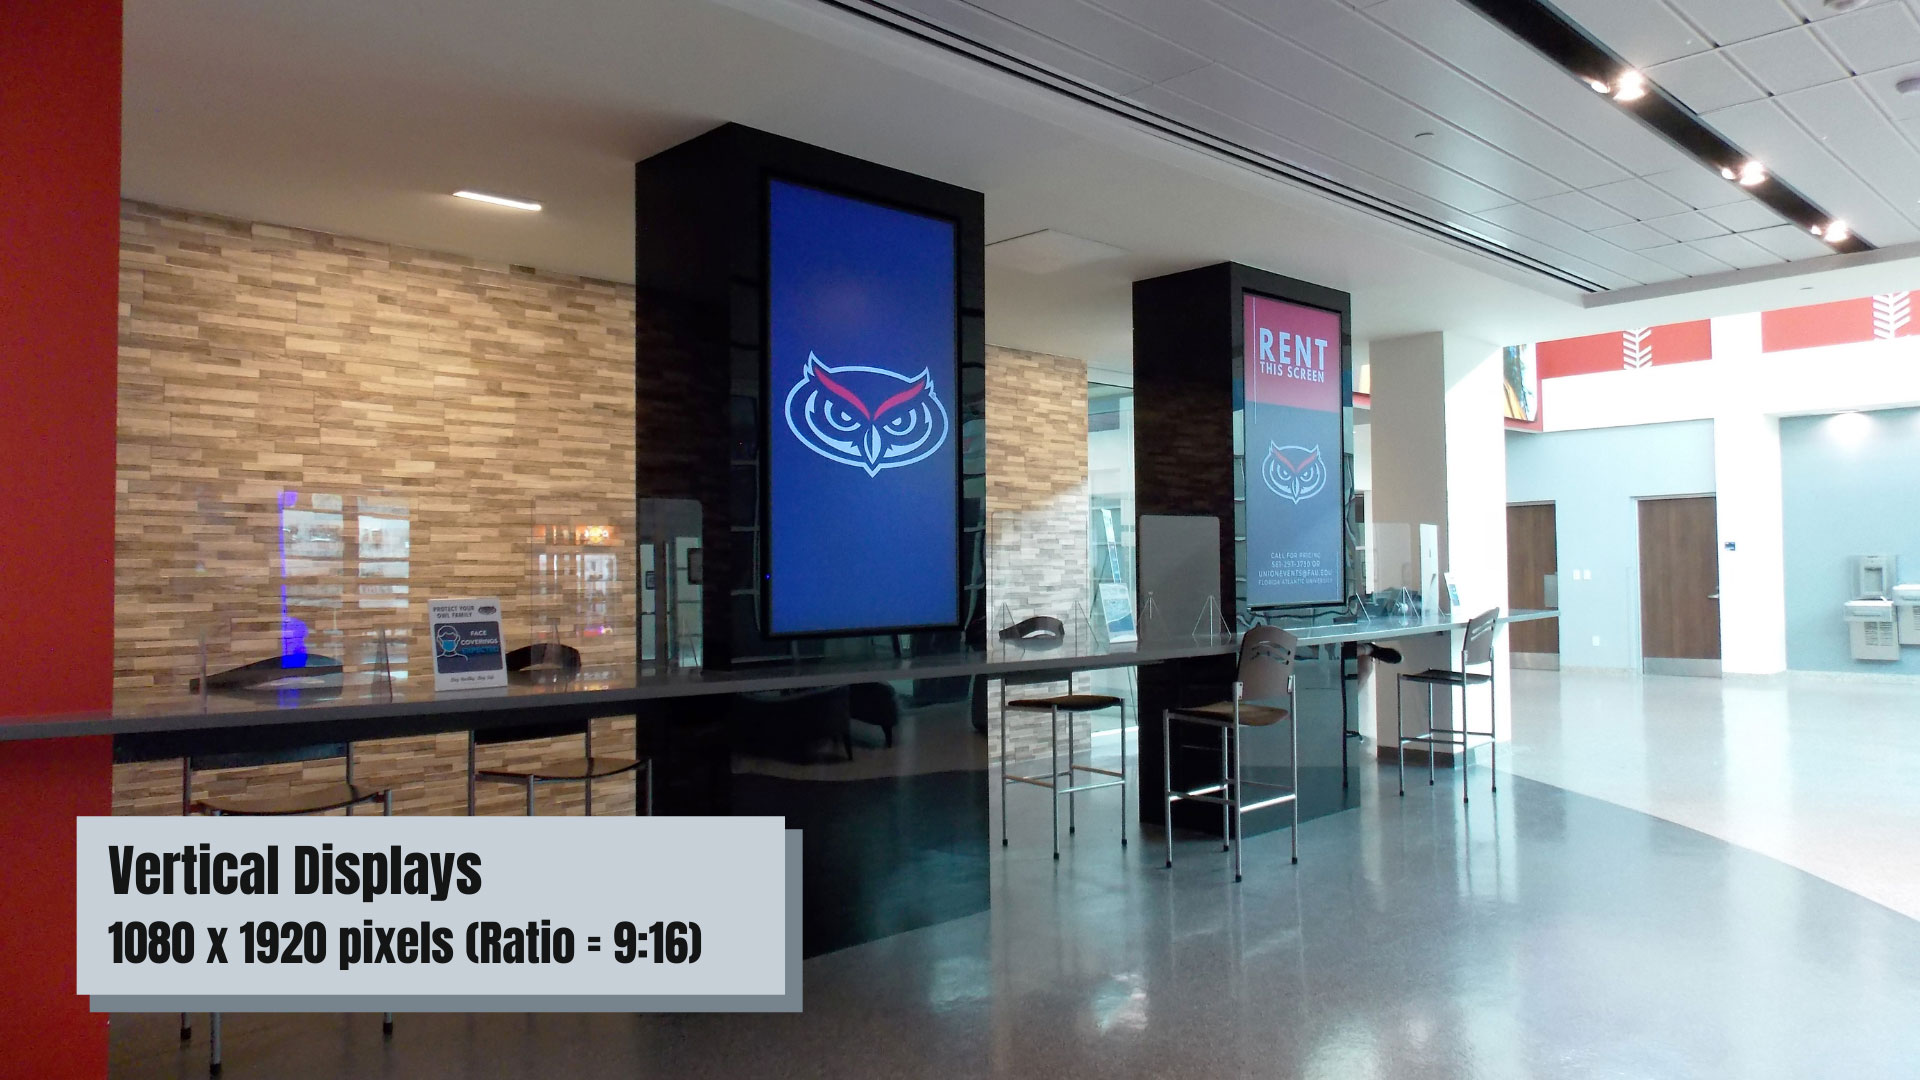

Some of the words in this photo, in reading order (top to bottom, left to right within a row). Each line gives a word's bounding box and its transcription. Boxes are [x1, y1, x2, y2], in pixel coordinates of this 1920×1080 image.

[1259, 327, 1328, 371] RENT
[1260, 361, 1283, 376] THIS
[1287, 365, 1324, 383] SCREEN
